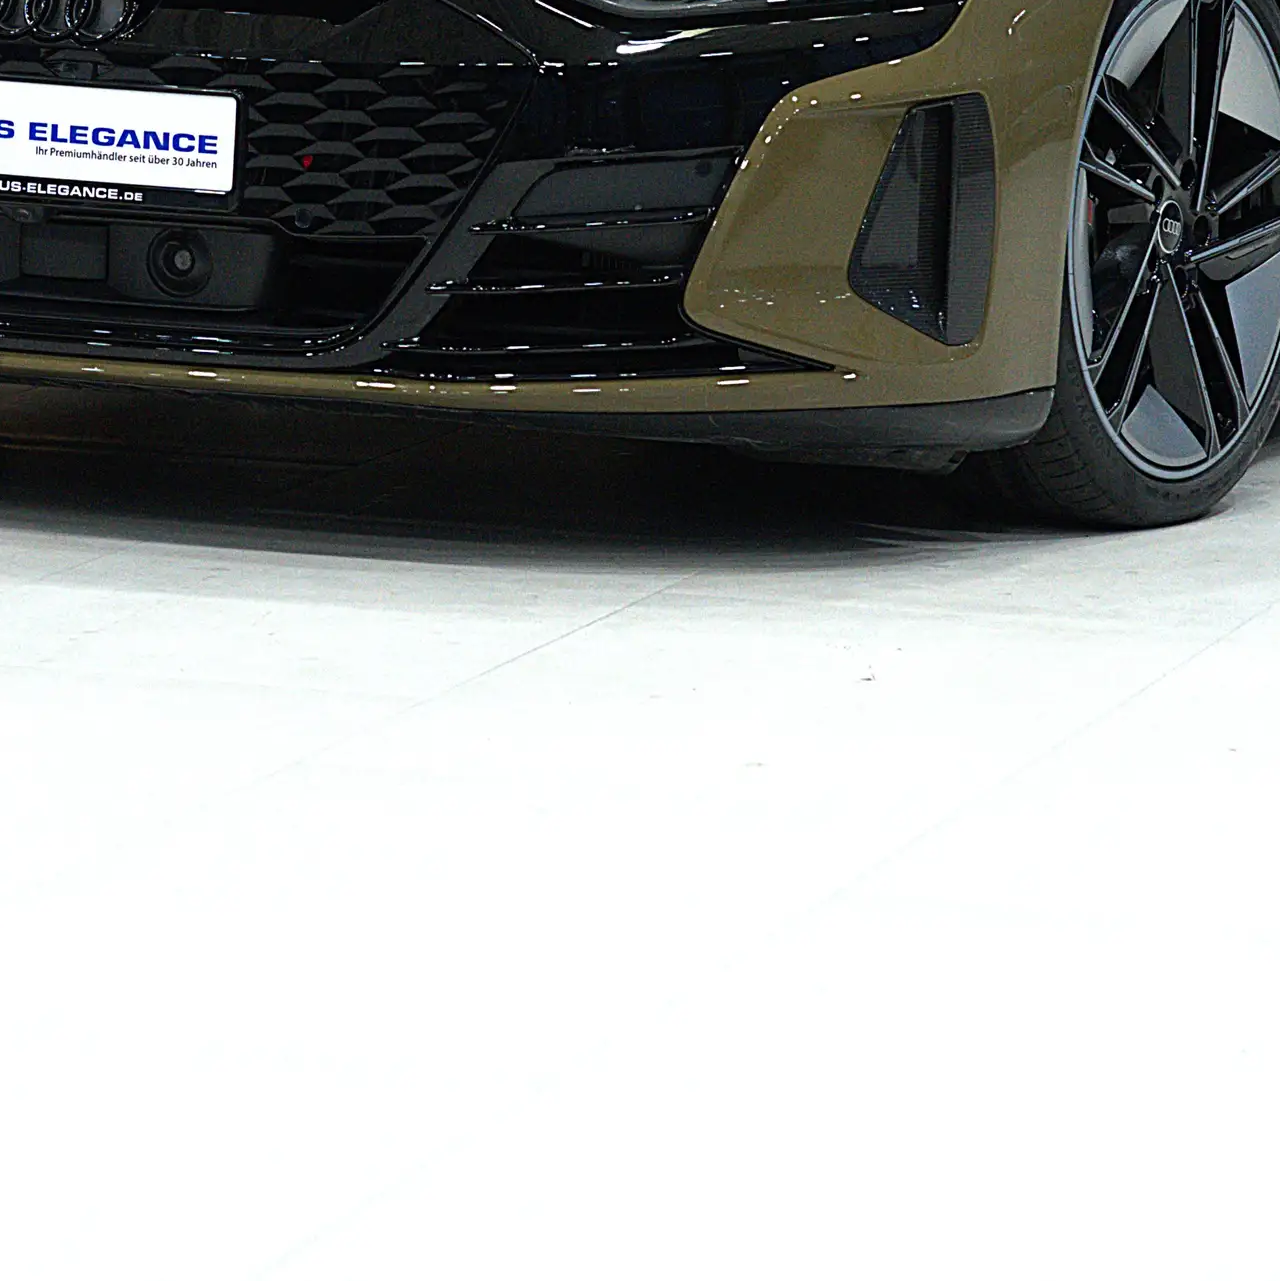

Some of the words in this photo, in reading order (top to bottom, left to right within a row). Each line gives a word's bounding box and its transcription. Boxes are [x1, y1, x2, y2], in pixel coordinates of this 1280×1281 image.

[27, 120, 219, 156] ELEGANCE
[35, 146, 49, 156] Ihr
[49, 147, 128, 162] Premiumhändler
[129, 154, 146, 164] seit
[147, 154, 171, 166] über
[171, 156, 184, 167] 30
[185, 157, 218, 169] Jahren
